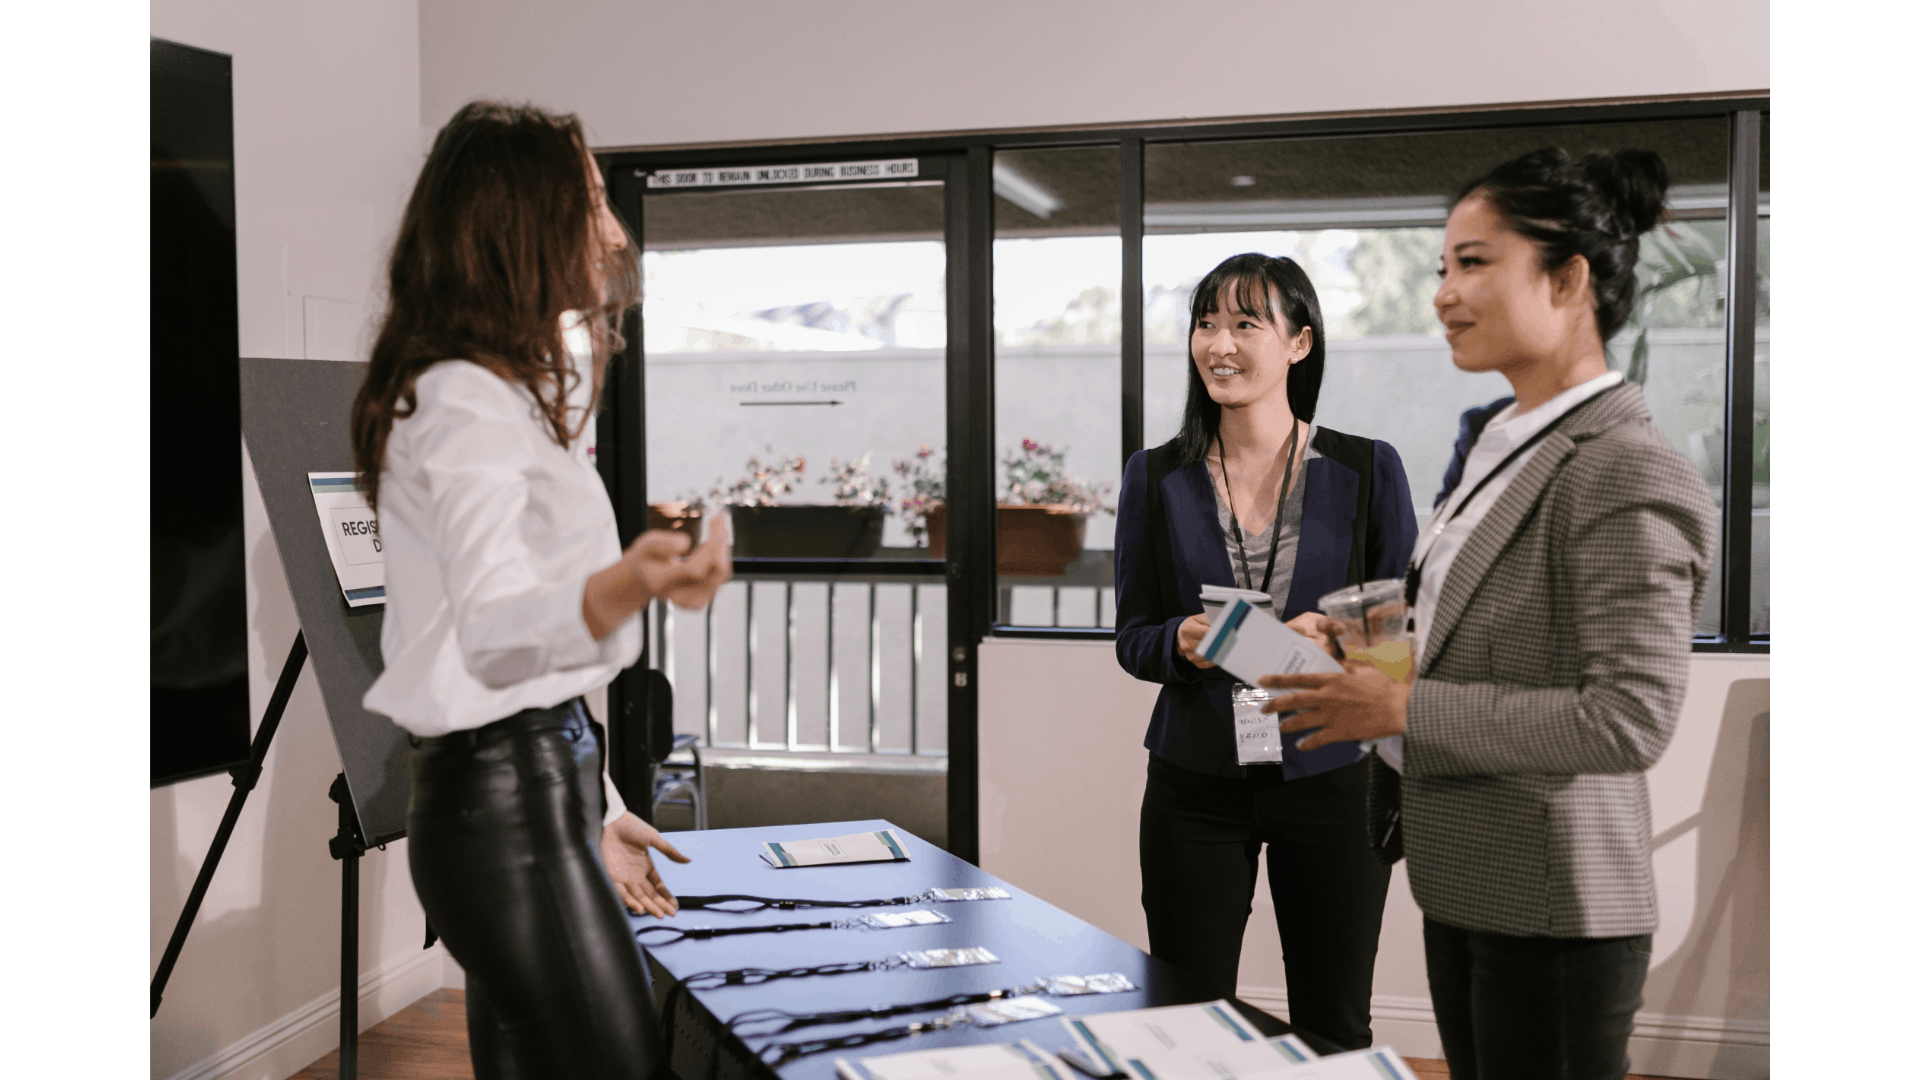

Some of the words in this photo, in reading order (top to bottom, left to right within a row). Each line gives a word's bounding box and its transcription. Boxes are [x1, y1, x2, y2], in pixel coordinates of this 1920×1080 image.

[675, 172, 696, 184] DOOR
[702, 171, 712, 183] TO
[718, 169, 751, 181] REMAIN
[757, 168, 799, 181] UNLOCKED
[804, 166, 835, 178] DURING
[840, 164, 879, 177] BUSINESS
[885, 163, 914, 175] HOURS
